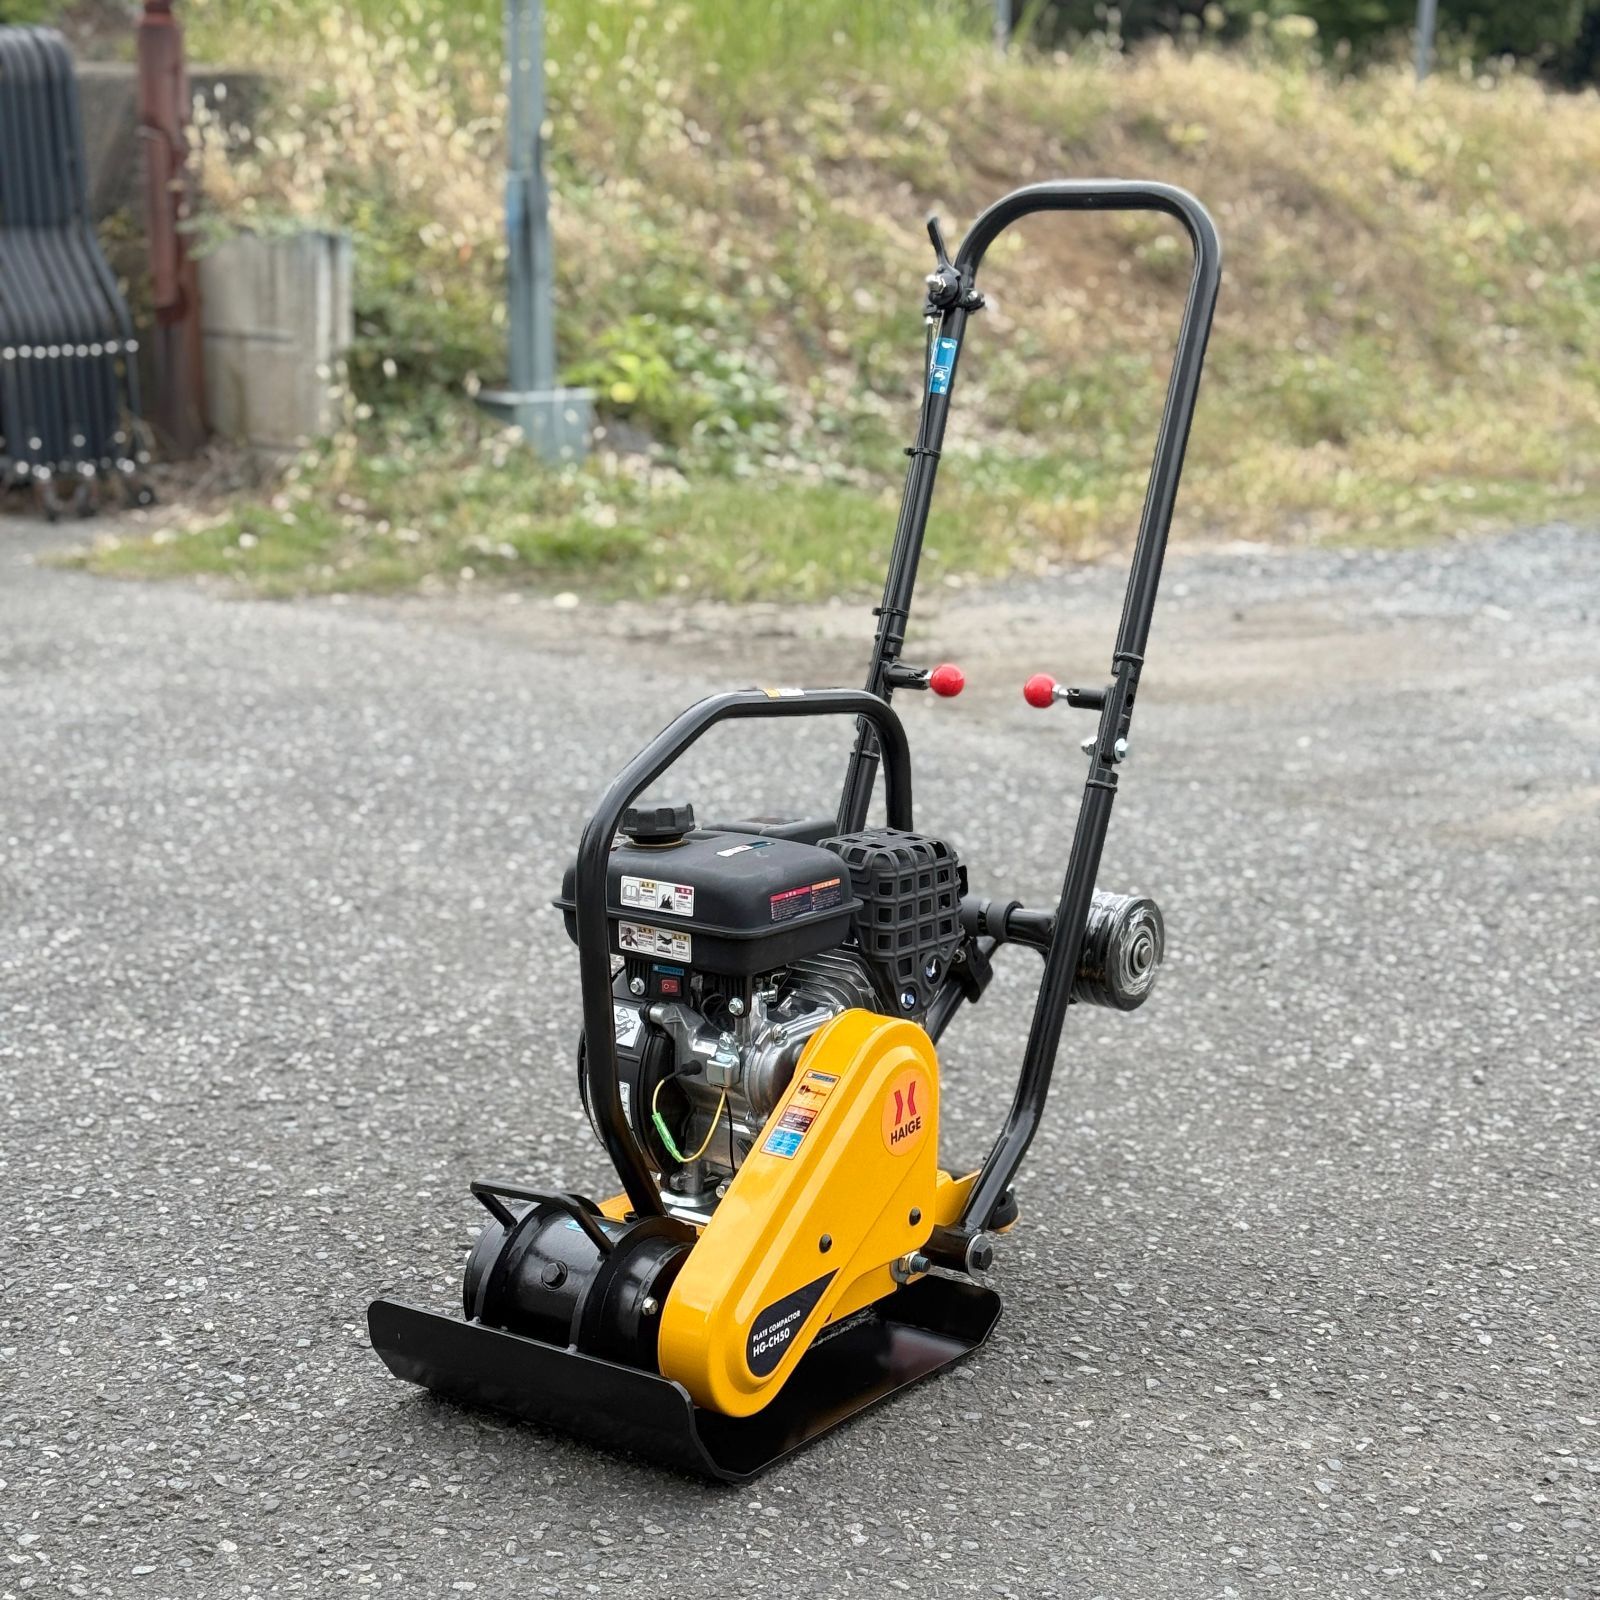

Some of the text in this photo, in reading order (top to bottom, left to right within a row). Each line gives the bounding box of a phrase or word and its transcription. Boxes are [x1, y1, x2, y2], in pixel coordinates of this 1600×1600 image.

[890, 1116, 922, 1146] HAIGE
[753, 1310, 801, 1343] PLATE COMPACTOR
[753, 1327, 790, 1358] HG-CH50
